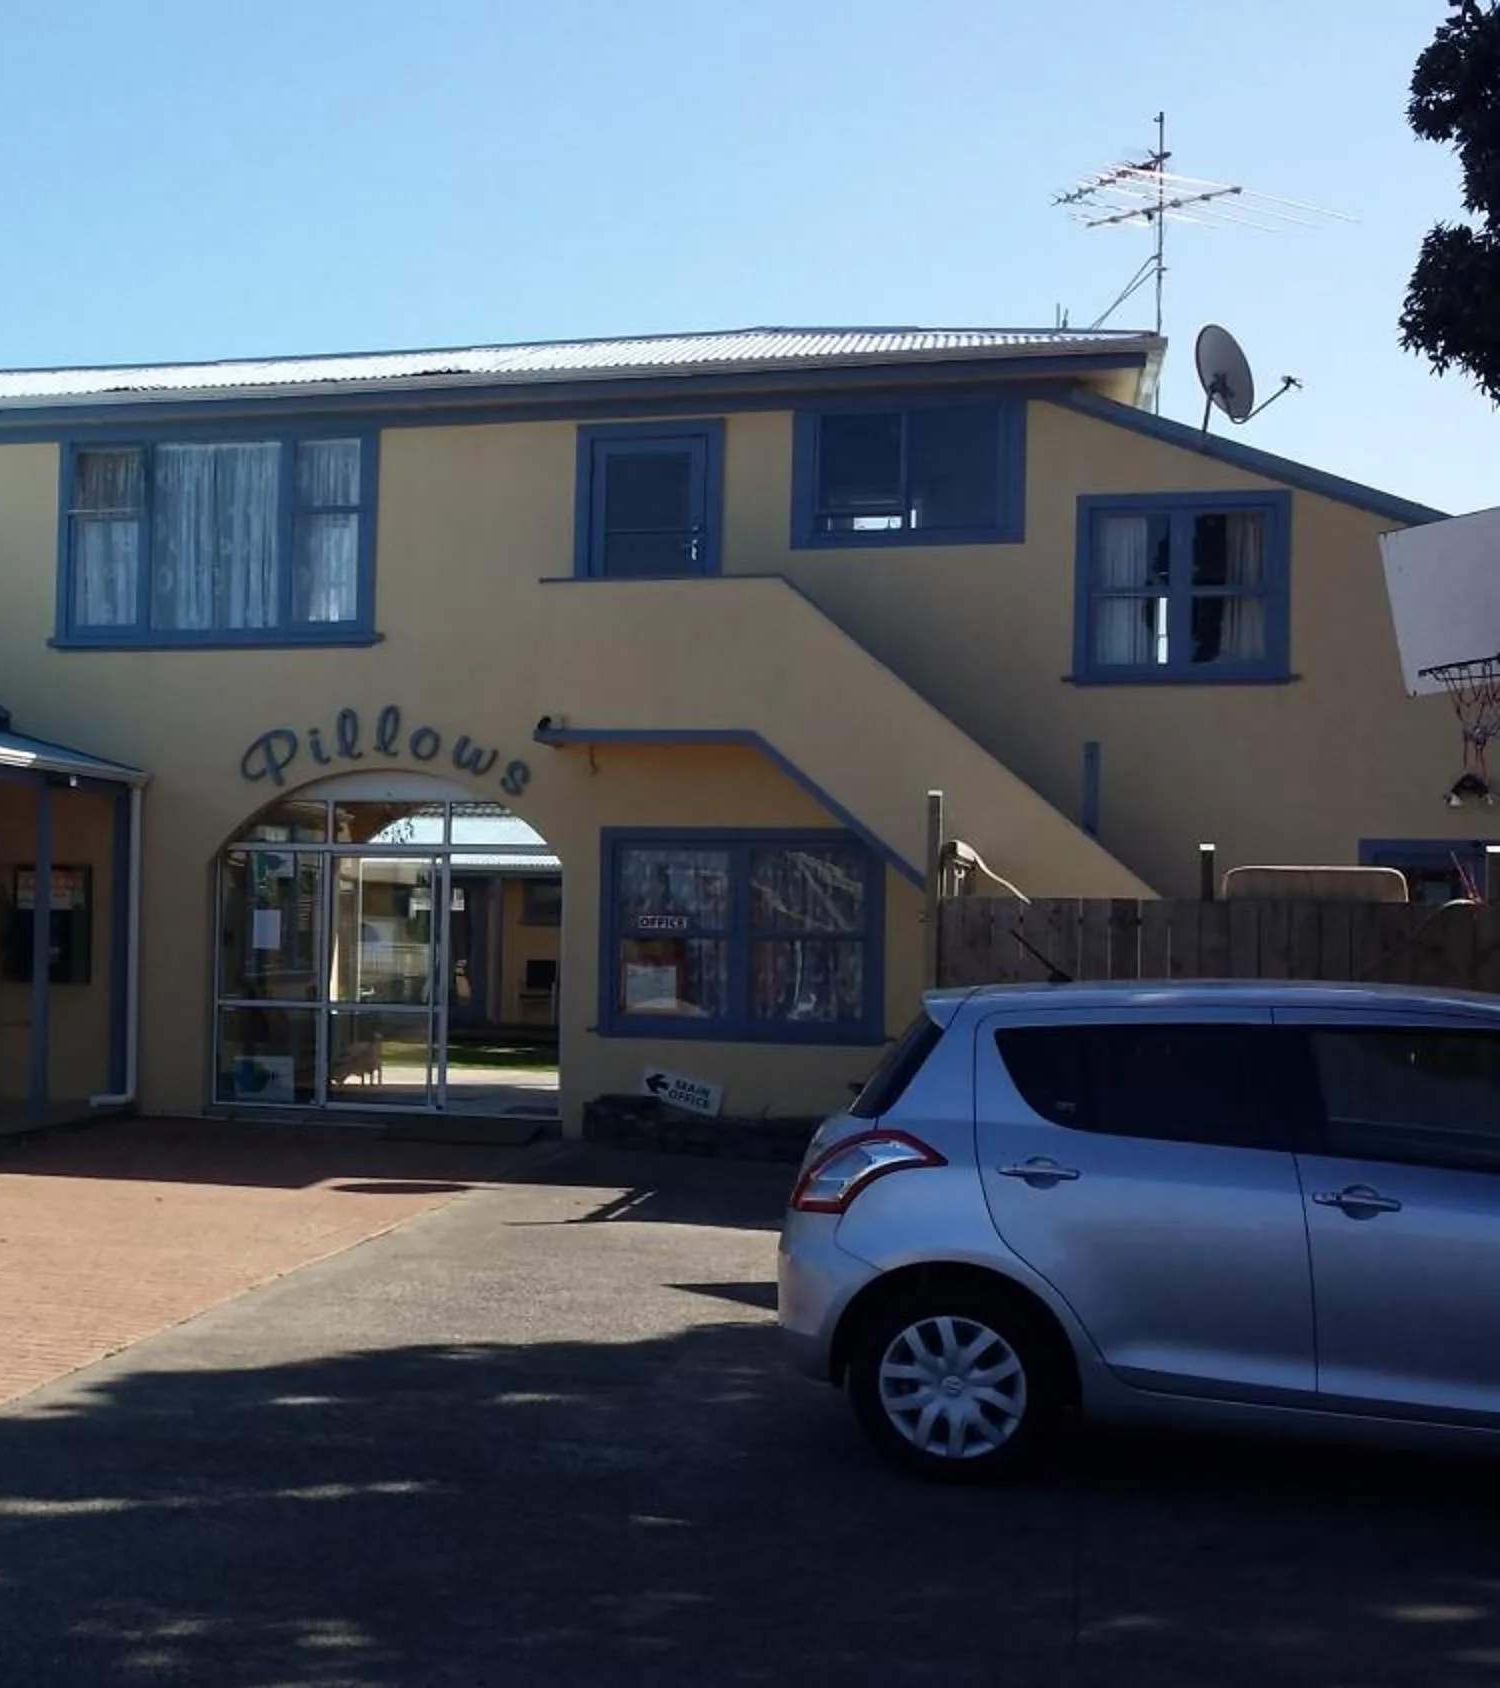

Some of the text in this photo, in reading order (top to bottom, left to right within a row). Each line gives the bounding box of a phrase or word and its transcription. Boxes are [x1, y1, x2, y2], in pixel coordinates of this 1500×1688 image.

[240, 704, 531, 797] Pillows
[640, 916, 685, 929] OFFICE
[675, 1079, 711, 1099] MAIN
[668, 1089, 710, 1110] OFFICE
